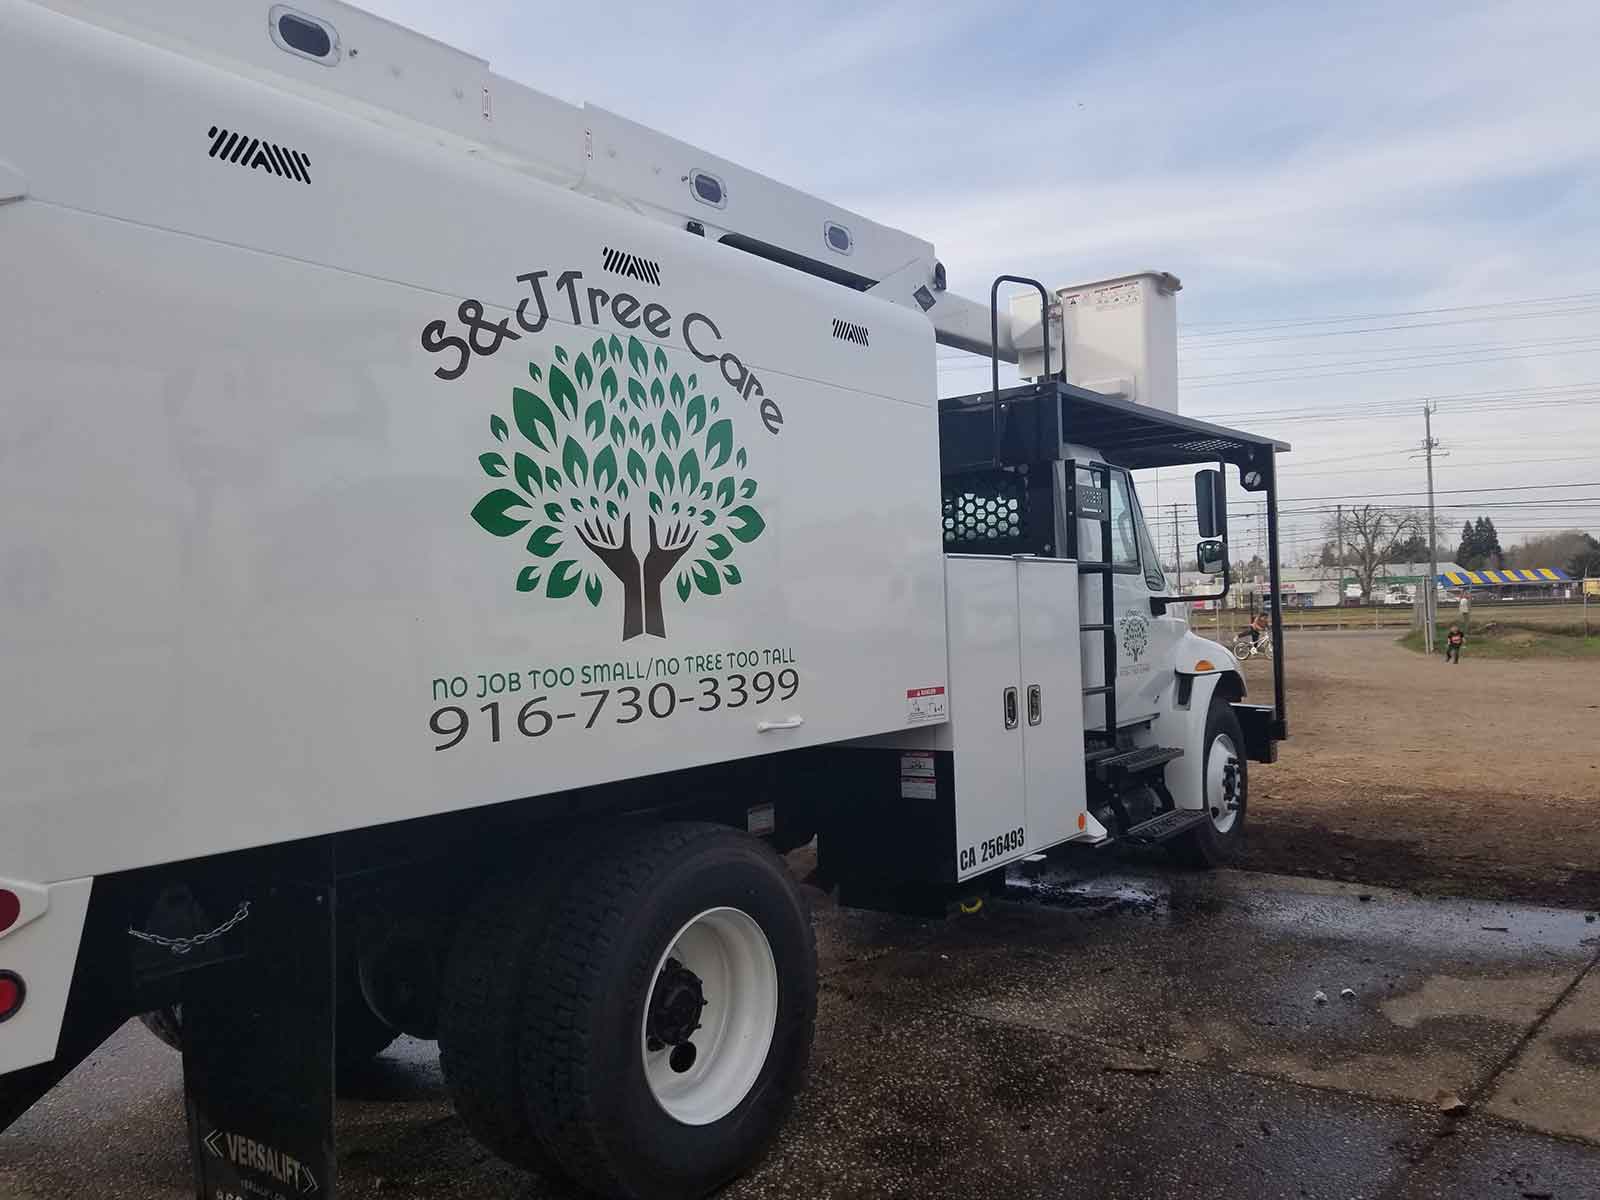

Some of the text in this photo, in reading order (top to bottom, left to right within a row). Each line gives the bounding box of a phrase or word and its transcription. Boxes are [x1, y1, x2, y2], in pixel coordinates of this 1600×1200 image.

[421, 270, 784, 436] S&J Tree Care
[431, 676, 468, 701] NO
[476, 671, 521, 698] JOB
[528, 667, 575, 691] TOO
[685, 653, 722, 673] TREE
[727, 650, 759, 668] TOO
[762, 647, 796, 665] TALL
[428, 668, 800, 752] 916-730-3399
[960, 826, 1025, 871] CA 256493
[225, 1132, 301, 1190] VERSALIFT
